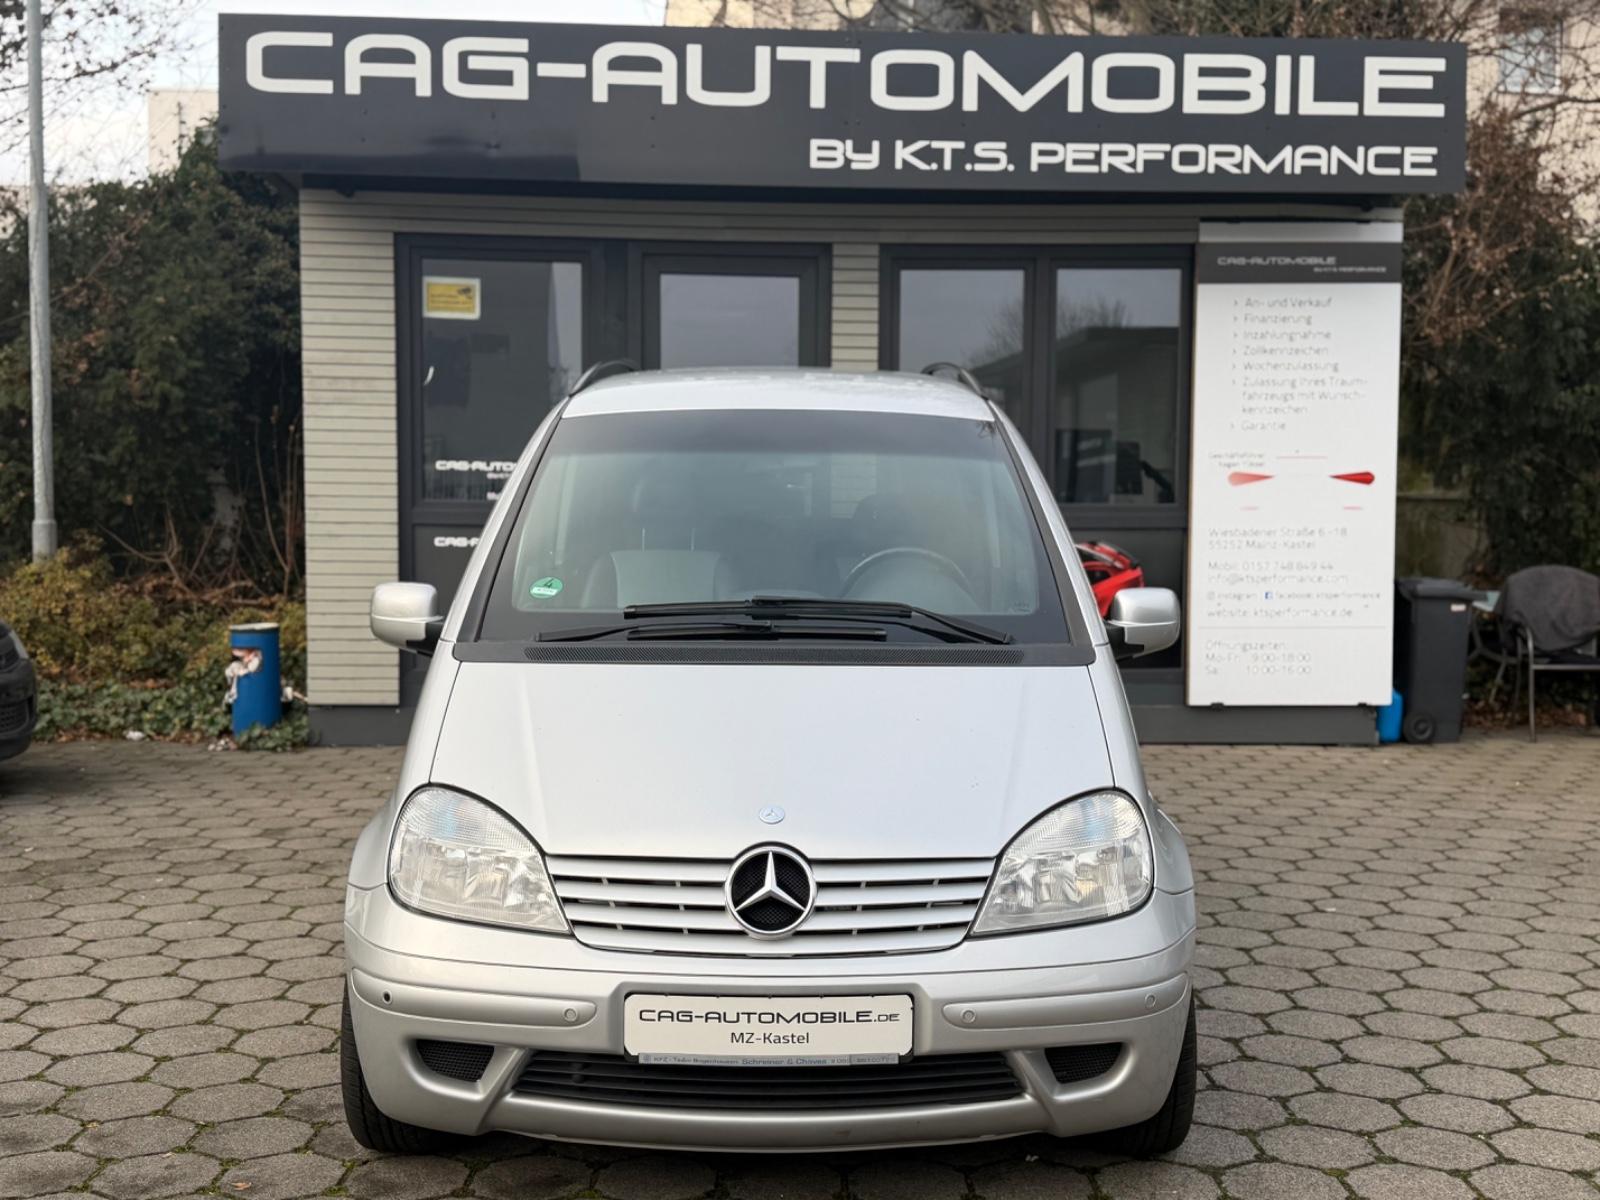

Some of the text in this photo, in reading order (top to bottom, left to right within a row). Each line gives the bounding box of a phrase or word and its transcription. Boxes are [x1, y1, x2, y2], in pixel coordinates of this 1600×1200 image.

[246, 31, 1446, 117] CAG-AUTOMOBILE
[809, 139, 1438, 176] BY K.T.S. PERFORMANCE
[1217, 256, 1337, 266] CAG-AUTOMOBILE
[1267, 297, 1288, 307] und
[1290, 296, 1333, 307] Verkauf
[1243, 313, 1312, 325] Finanzierung
[1243, 361, 1339, 373] Wochenzulassung
[1241, 420, 1287, 431] Garantie
[1208, 527, 1277, 538] Wiesbadener
[1280, 526, 1316, 538] Straße
[639, 1009, 900, 1024] CAG-AUTOMOBILE.DE
[730, 1032, 810, 1044] MZ-Kastel
